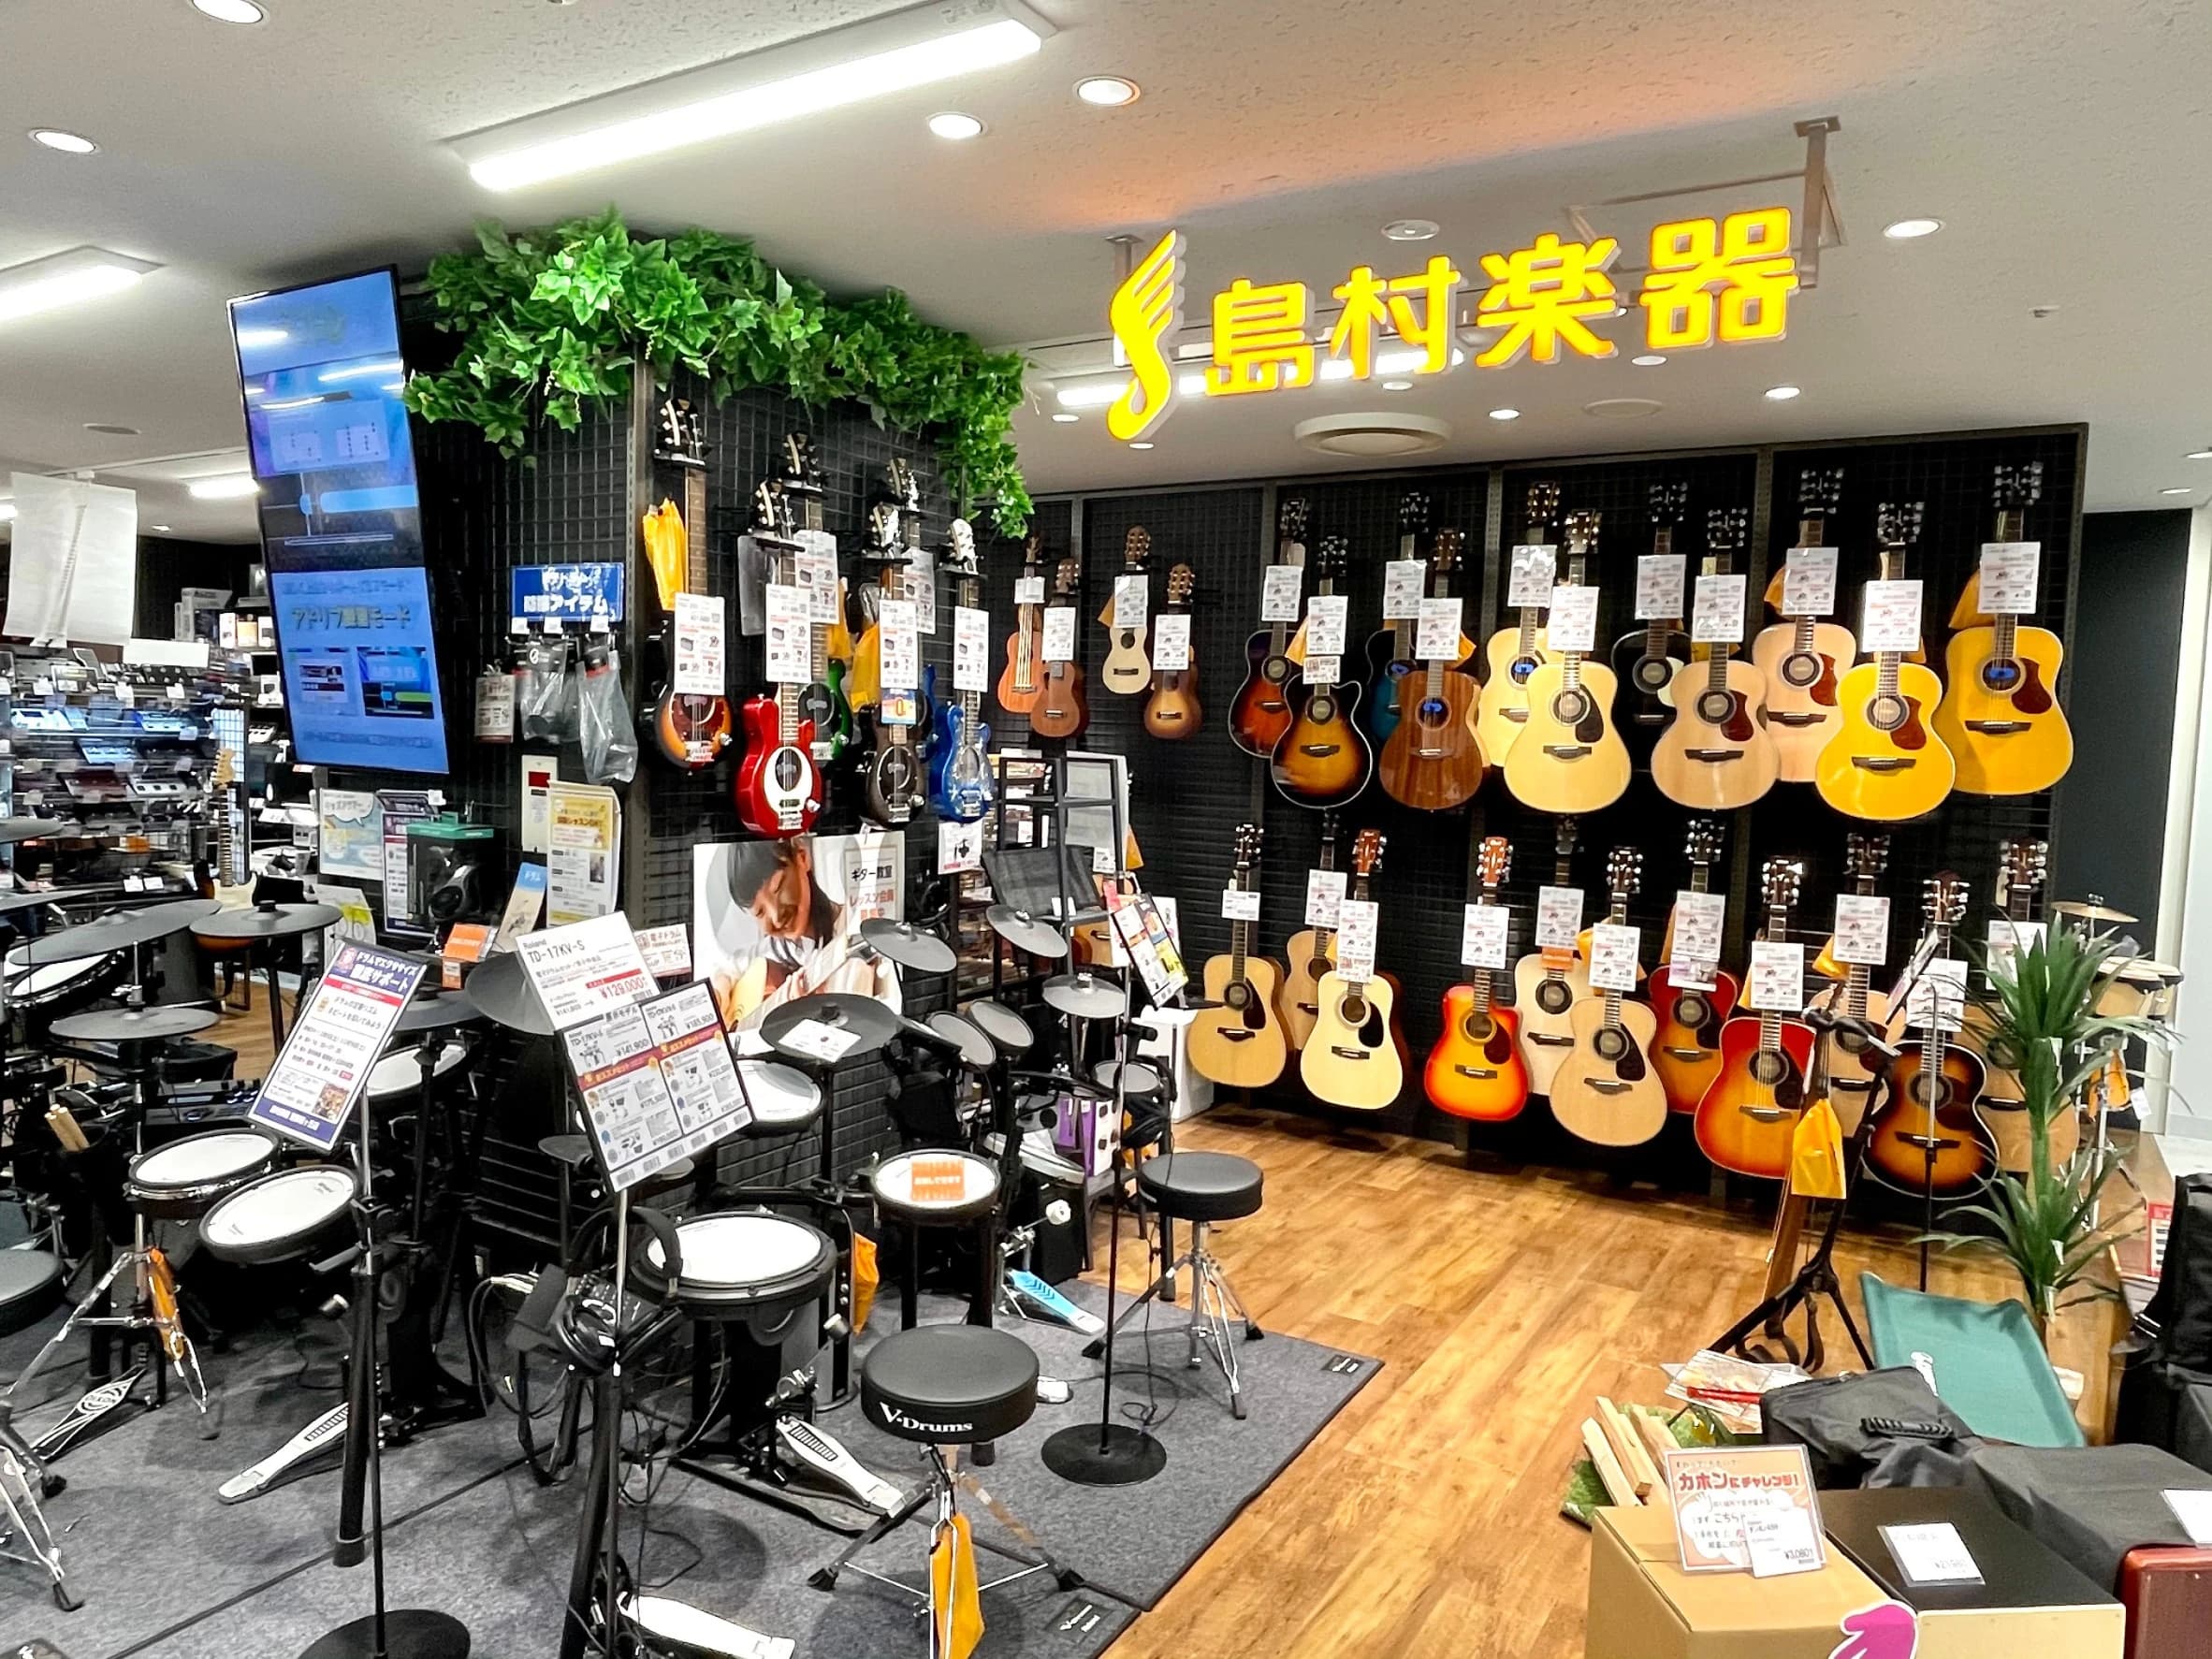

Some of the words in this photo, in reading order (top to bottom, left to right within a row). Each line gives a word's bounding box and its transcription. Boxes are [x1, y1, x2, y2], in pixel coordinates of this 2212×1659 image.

[1204, 207, 1799, 397] 島村楽器
[527, 939, 586, 964] TD-17KV-S
